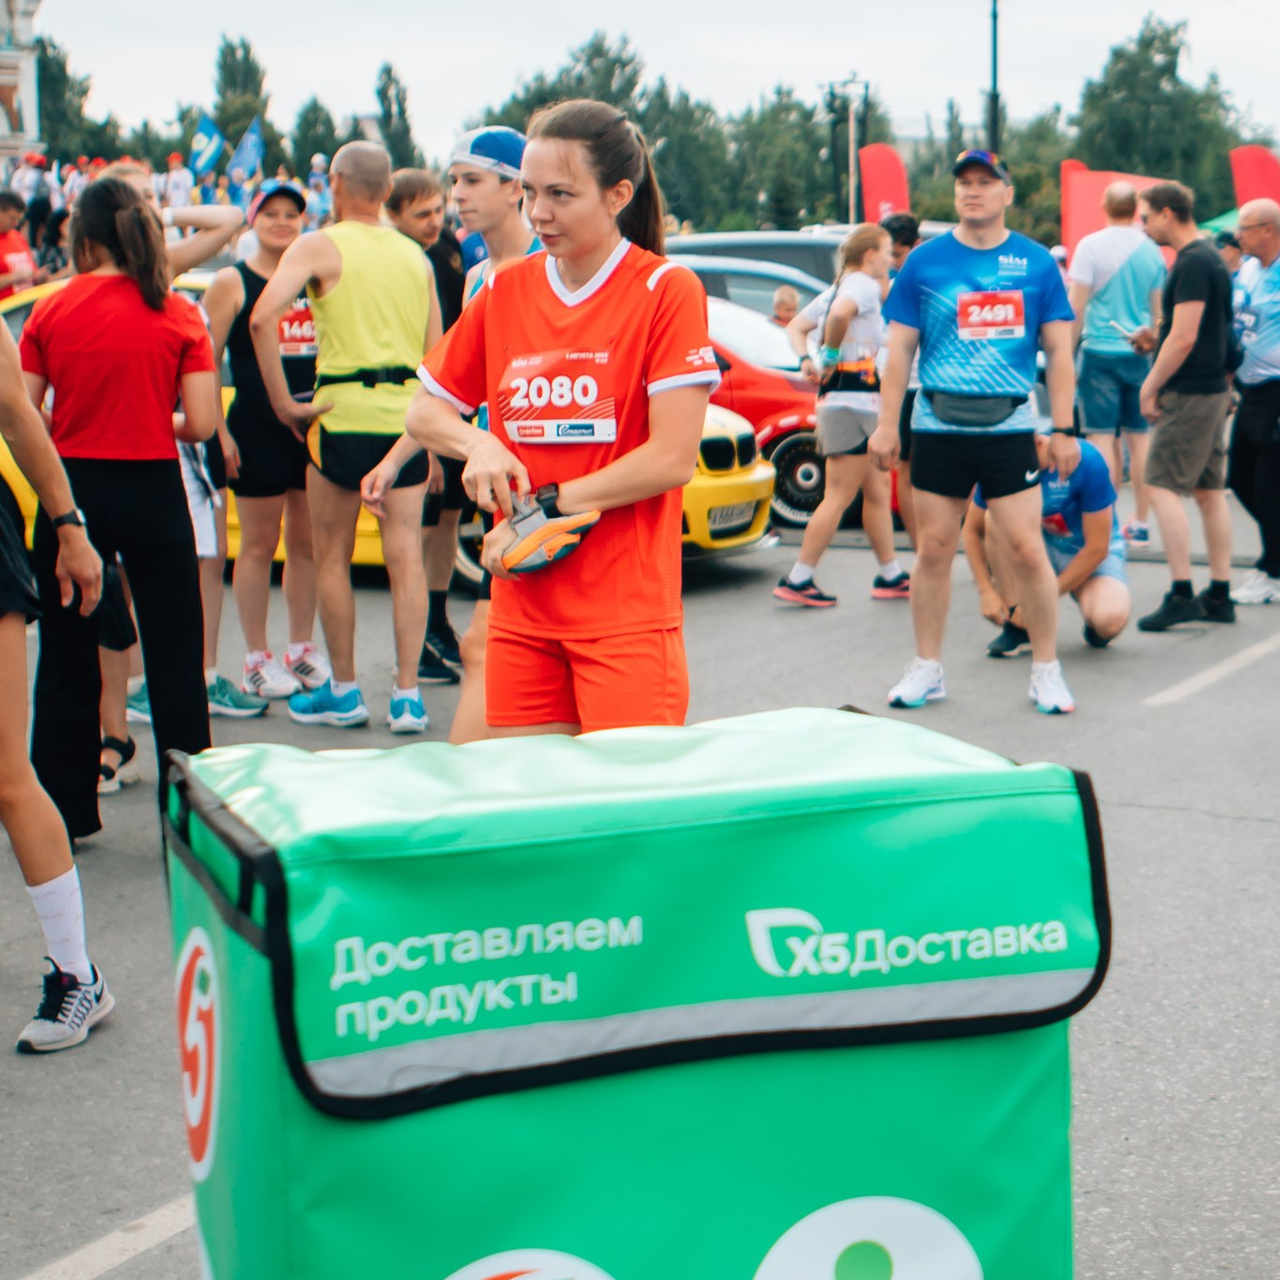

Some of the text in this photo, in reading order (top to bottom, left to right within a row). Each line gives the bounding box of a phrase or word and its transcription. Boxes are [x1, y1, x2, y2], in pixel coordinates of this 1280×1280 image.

[967, 304, 1015, 325] 2491
[510, 375, 598, 407] 2080
[330, 915, 644, 991] Доставляем
[335, 971, 578, 1042] продукты
